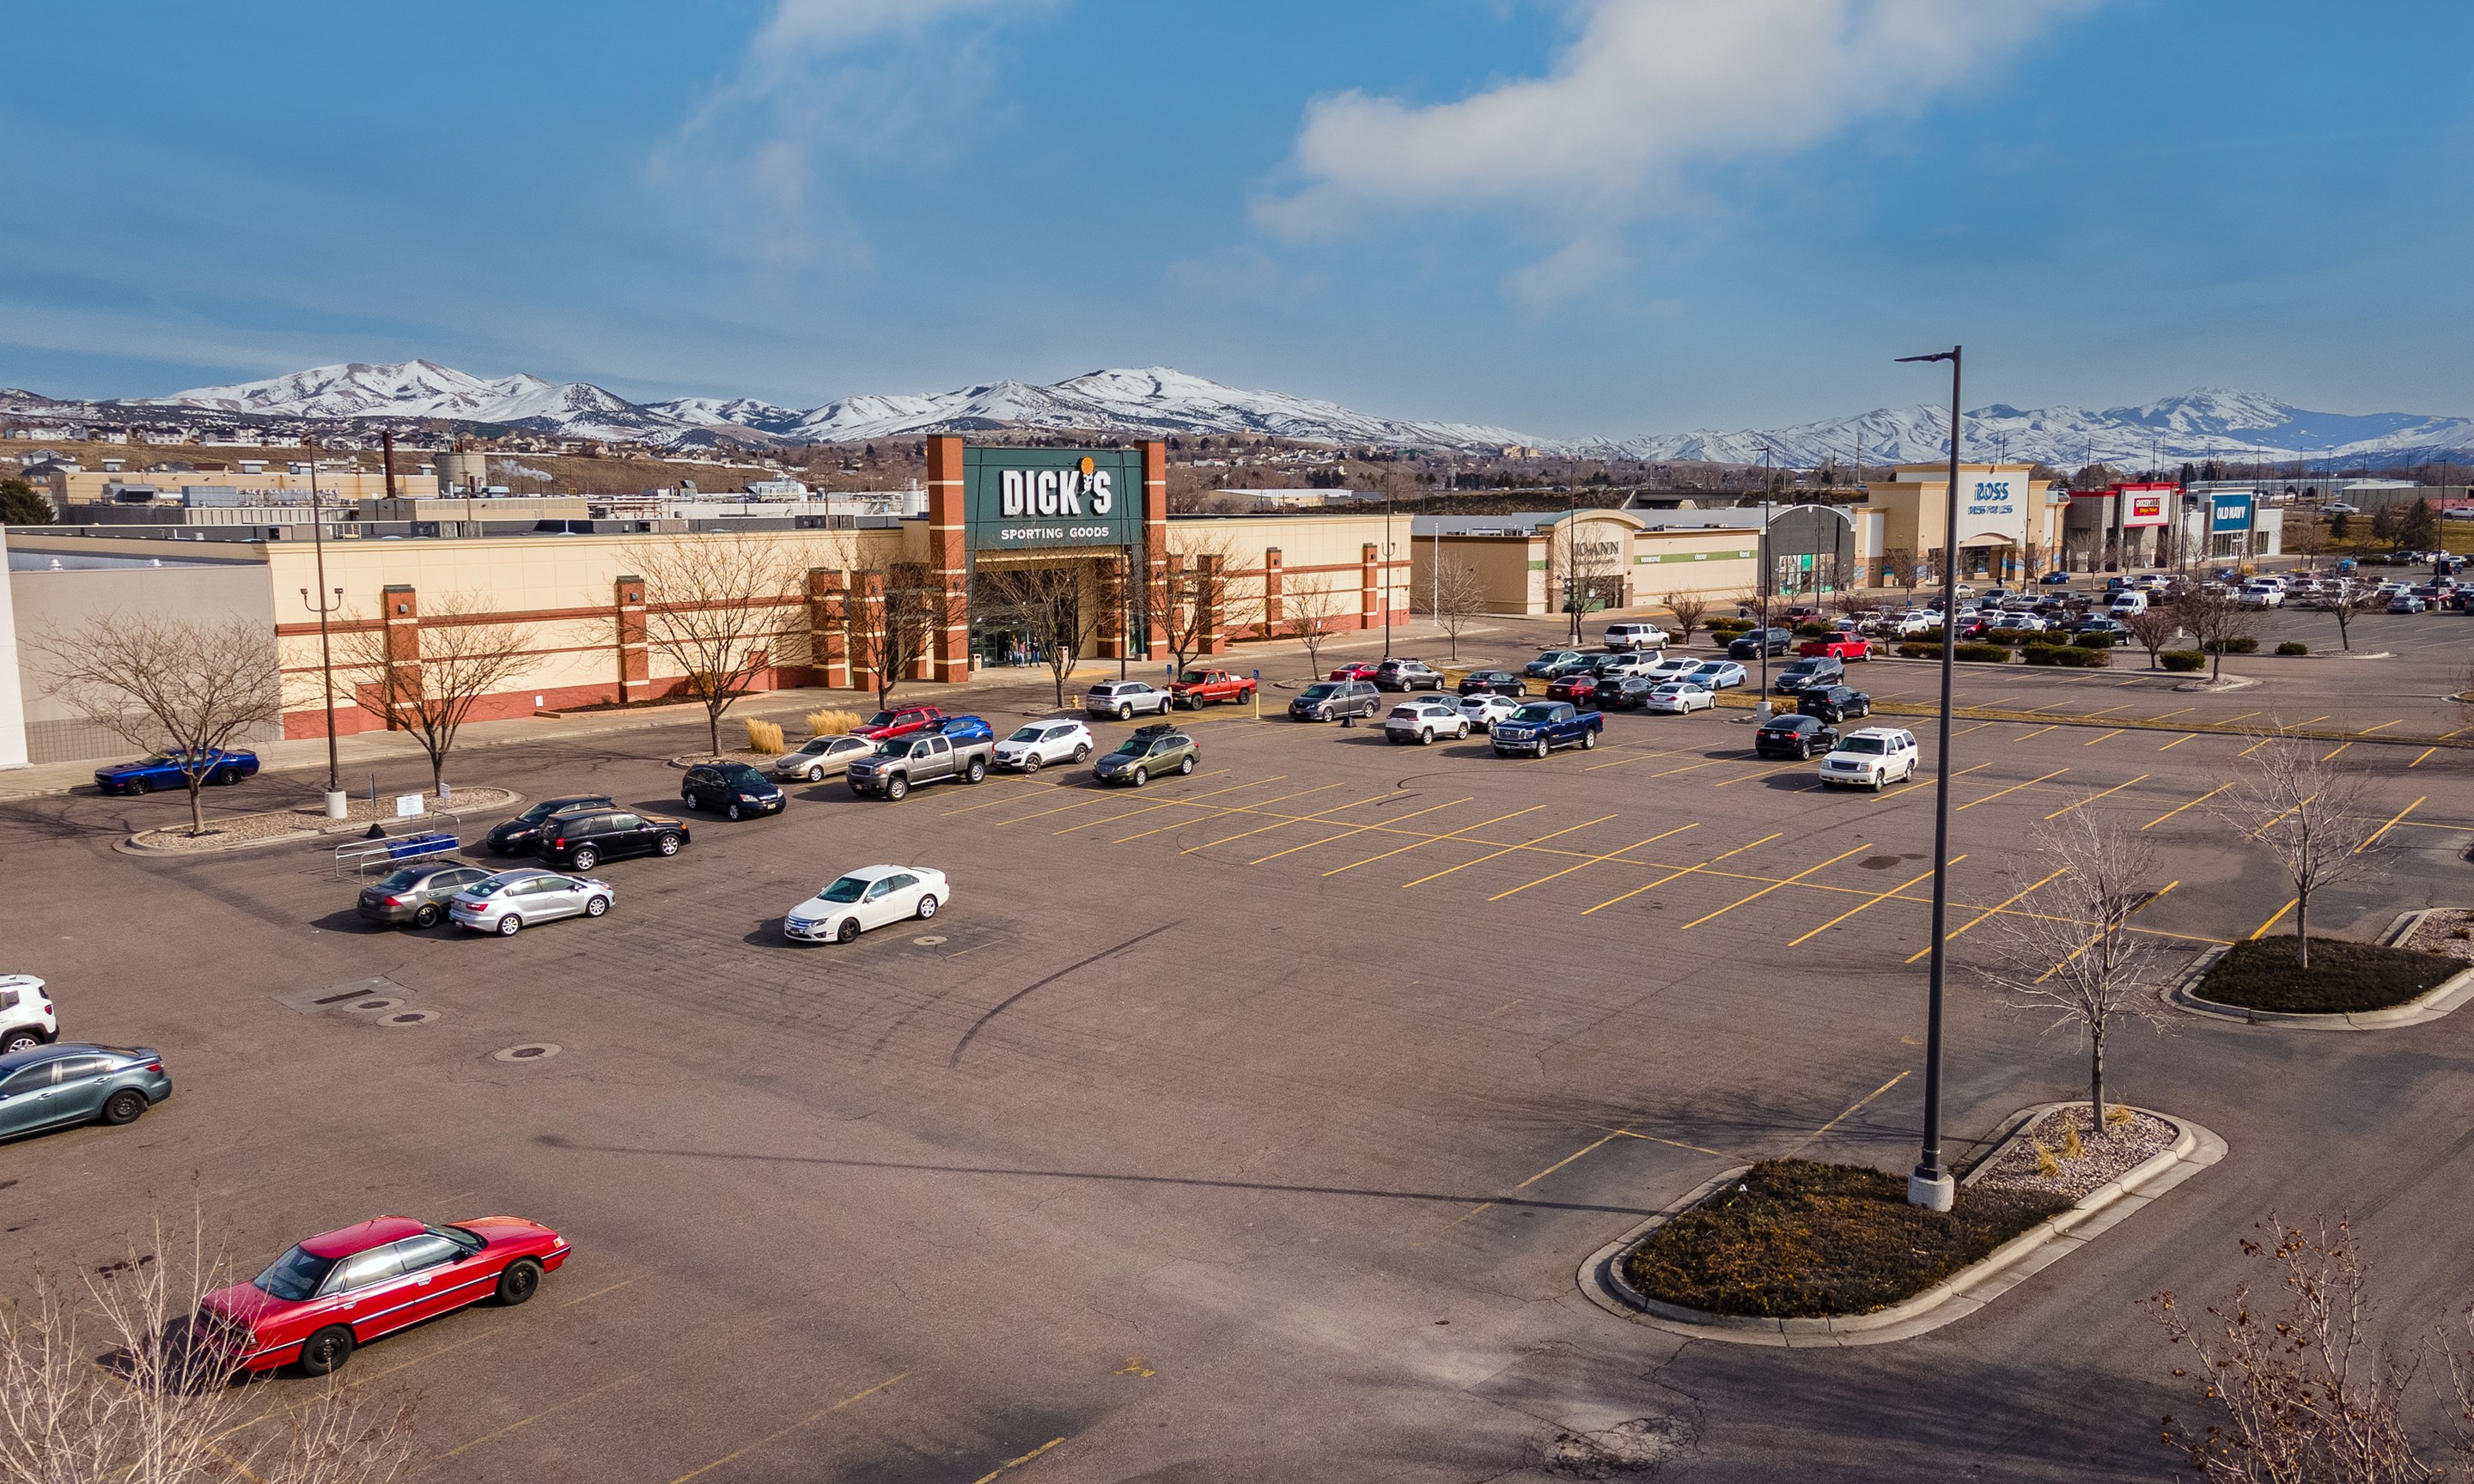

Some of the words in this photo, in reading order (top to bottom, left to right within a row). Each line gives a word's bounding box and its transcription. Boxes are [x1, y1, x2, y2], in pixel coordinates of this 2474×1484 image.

[1002, 466, 1112, 515] DICK'S
[1974, 482, 2009, 501] ROSS
[2217, 507, 2228, 520] OLD
[2229, 507, 2245, 520] NAVY
[1001, 527, 1063, 539] SPORTING
[1069, 526, 1110, 538] GOODS
